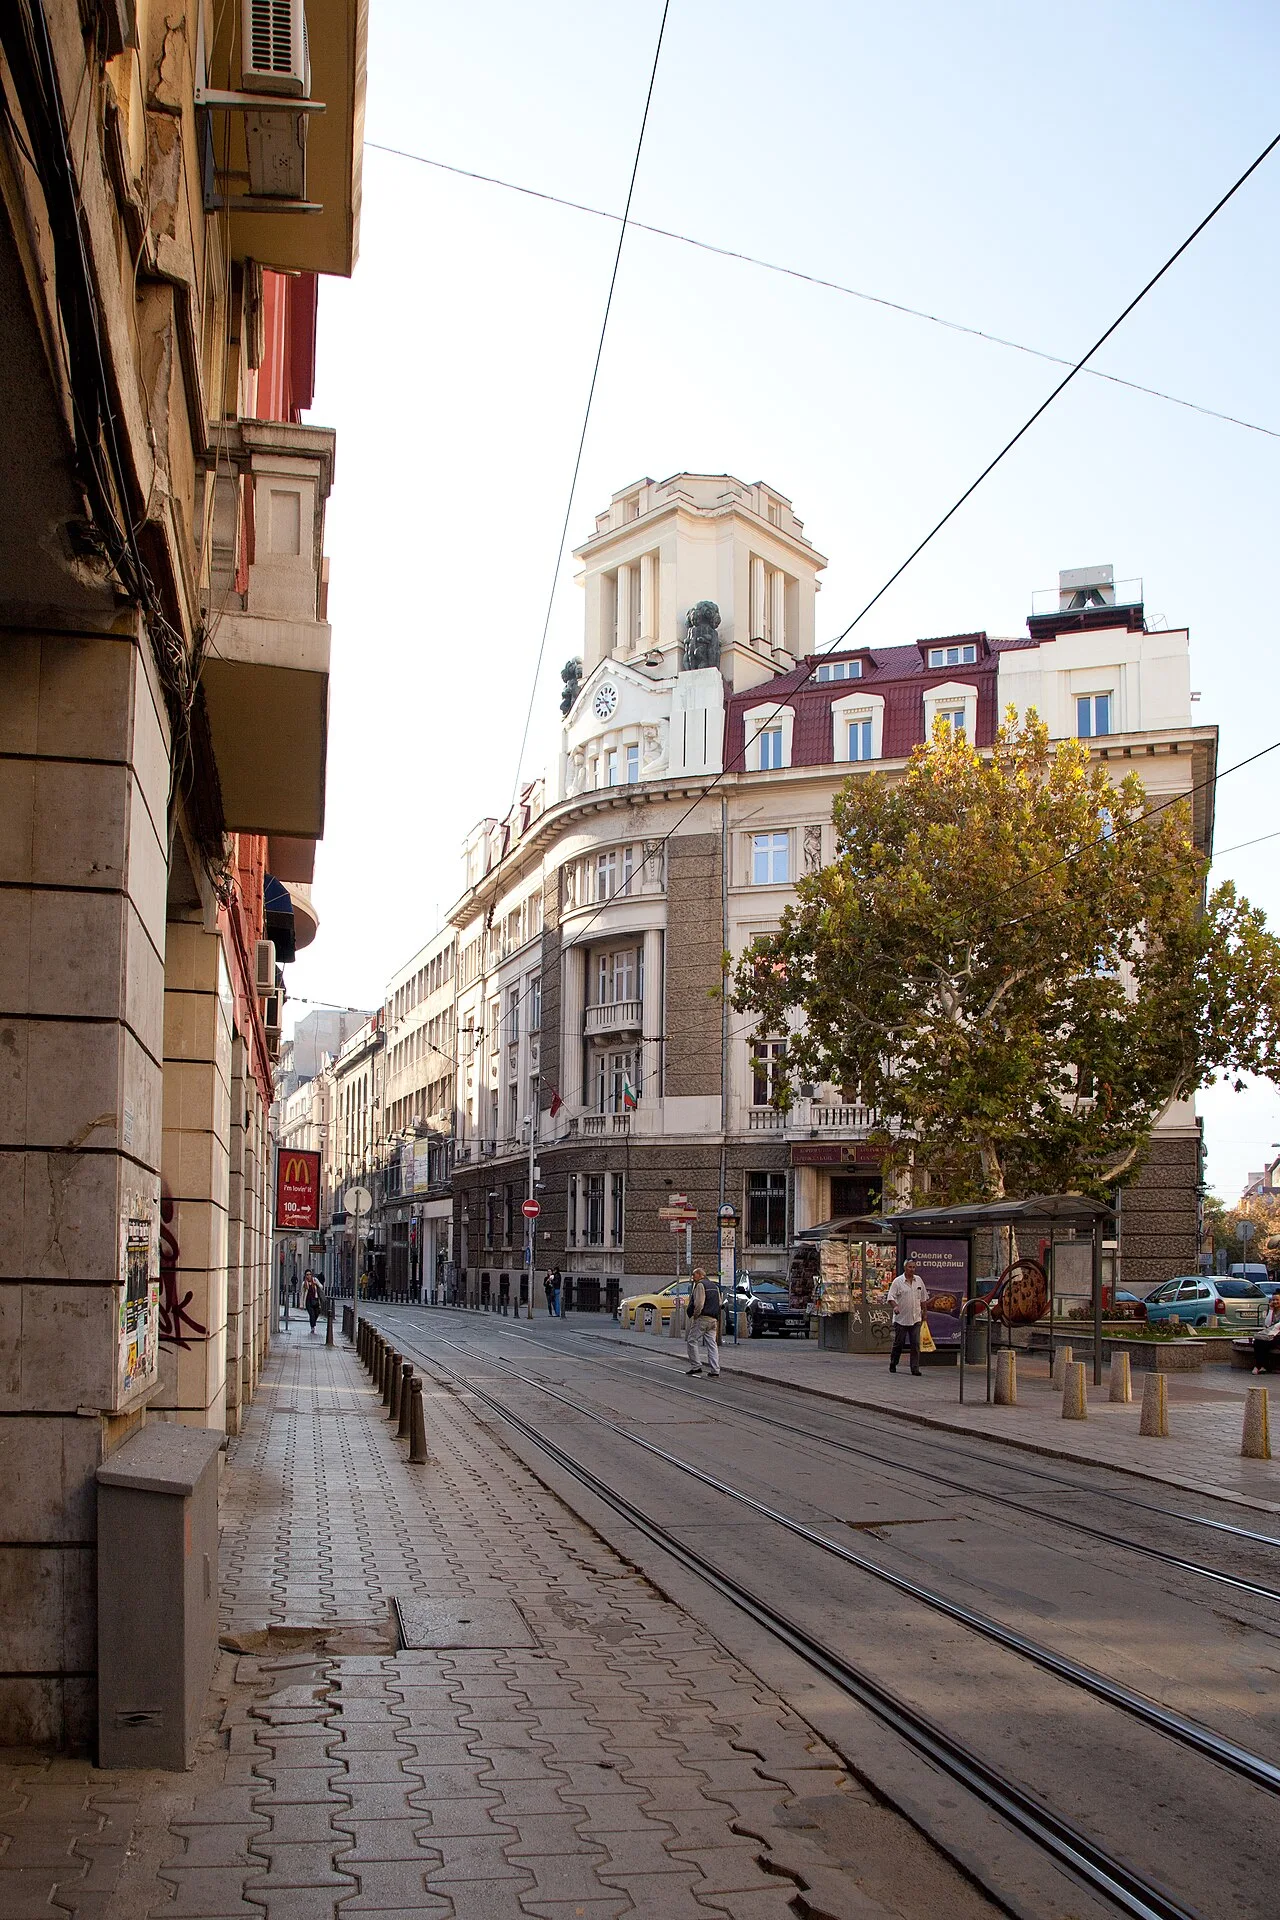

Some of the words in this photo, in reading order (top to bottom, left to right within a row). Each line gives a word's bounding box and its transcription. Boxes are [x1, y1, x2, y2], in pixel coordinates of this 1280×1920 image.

[284, 1202, 297, 1212] 100
[910, 1251, 942, 1260] Осмели
[923, 1260, 964, 1268] споделиш
